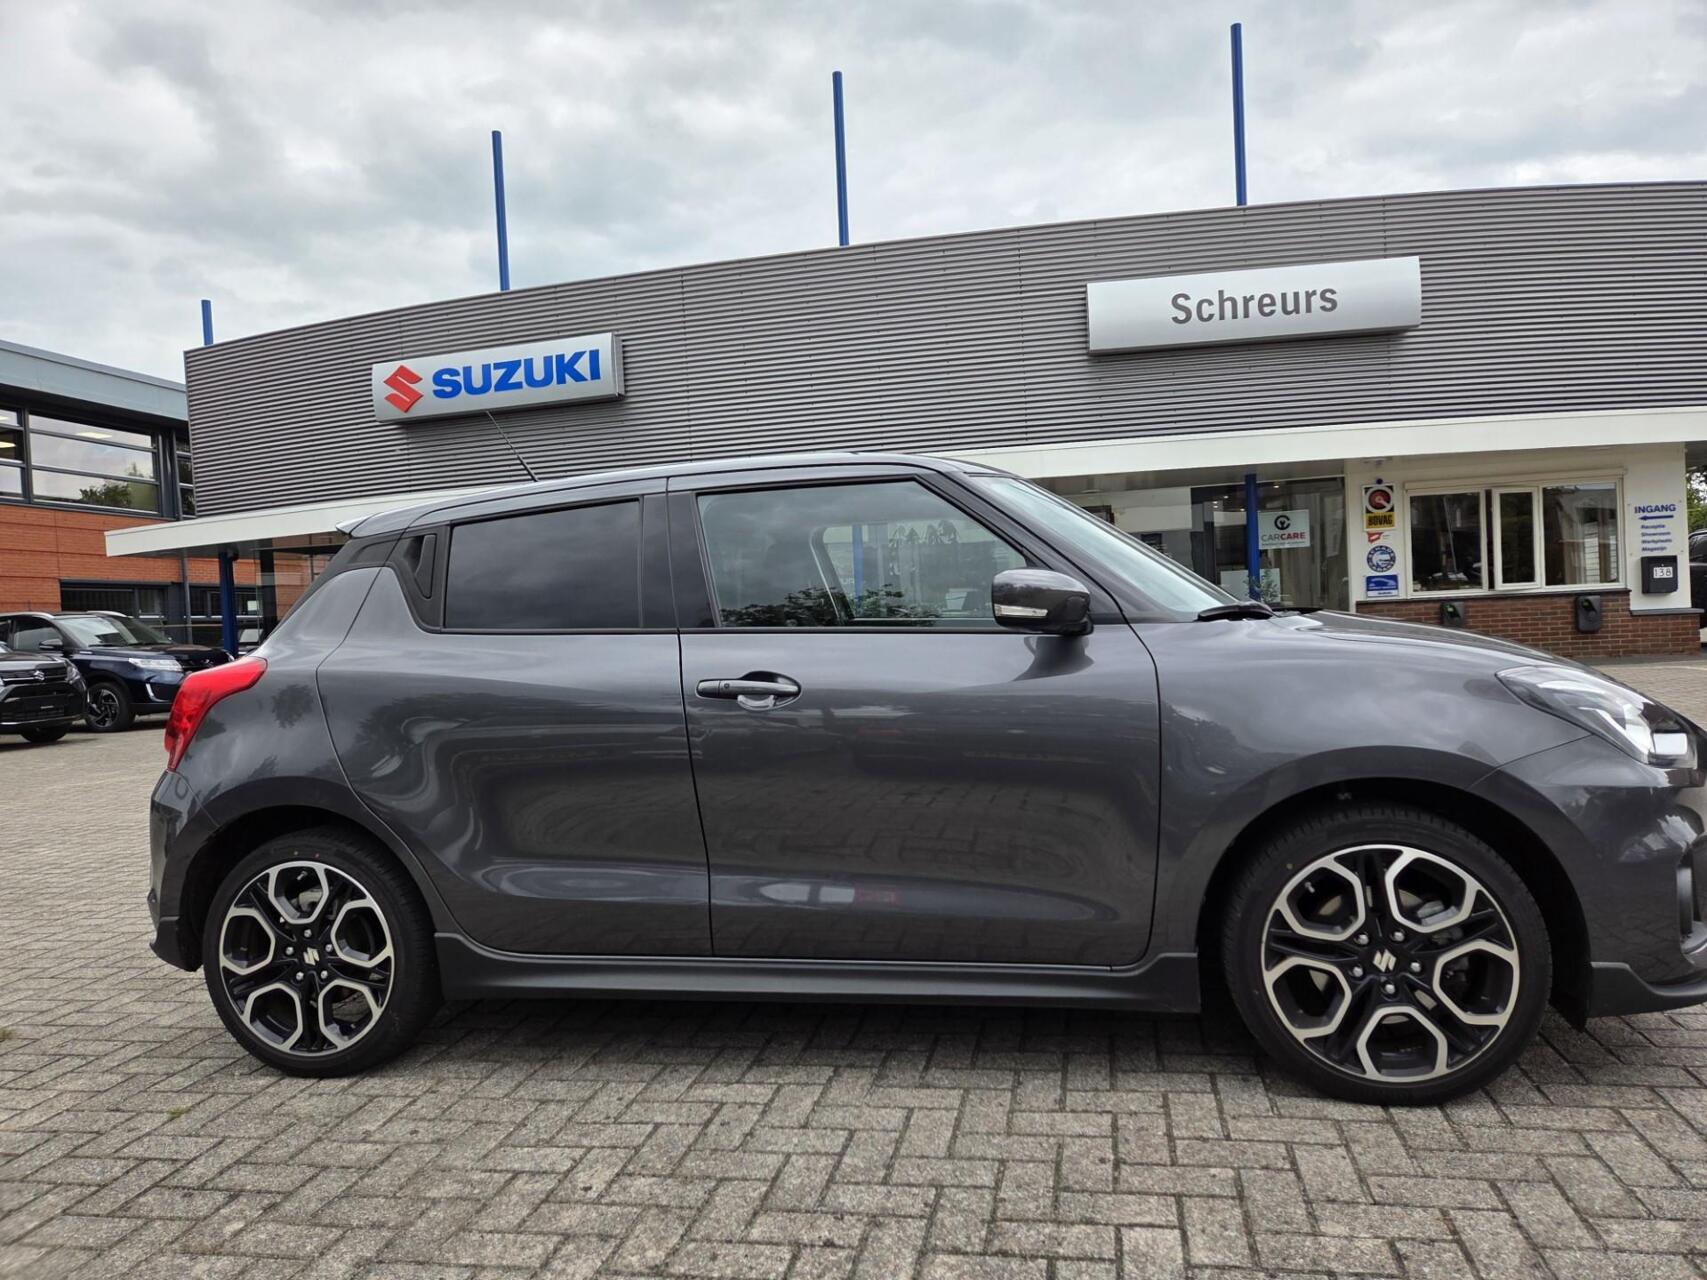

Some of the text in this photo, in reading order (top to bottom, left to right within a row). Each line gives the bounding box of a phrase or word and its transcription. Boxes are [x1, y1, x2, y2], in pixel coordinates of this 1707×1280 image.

[1171, 287, 1338, 324] Schreurs
[432, 349, 601, 398] SUZUKI
[1634, 503, 1676, 514] INGANG
[1368, 515, 1393, 525] BOVAG
[1261, 531, 1306, 541] CARCARE
[1654, 568, 1671, 577] 138
